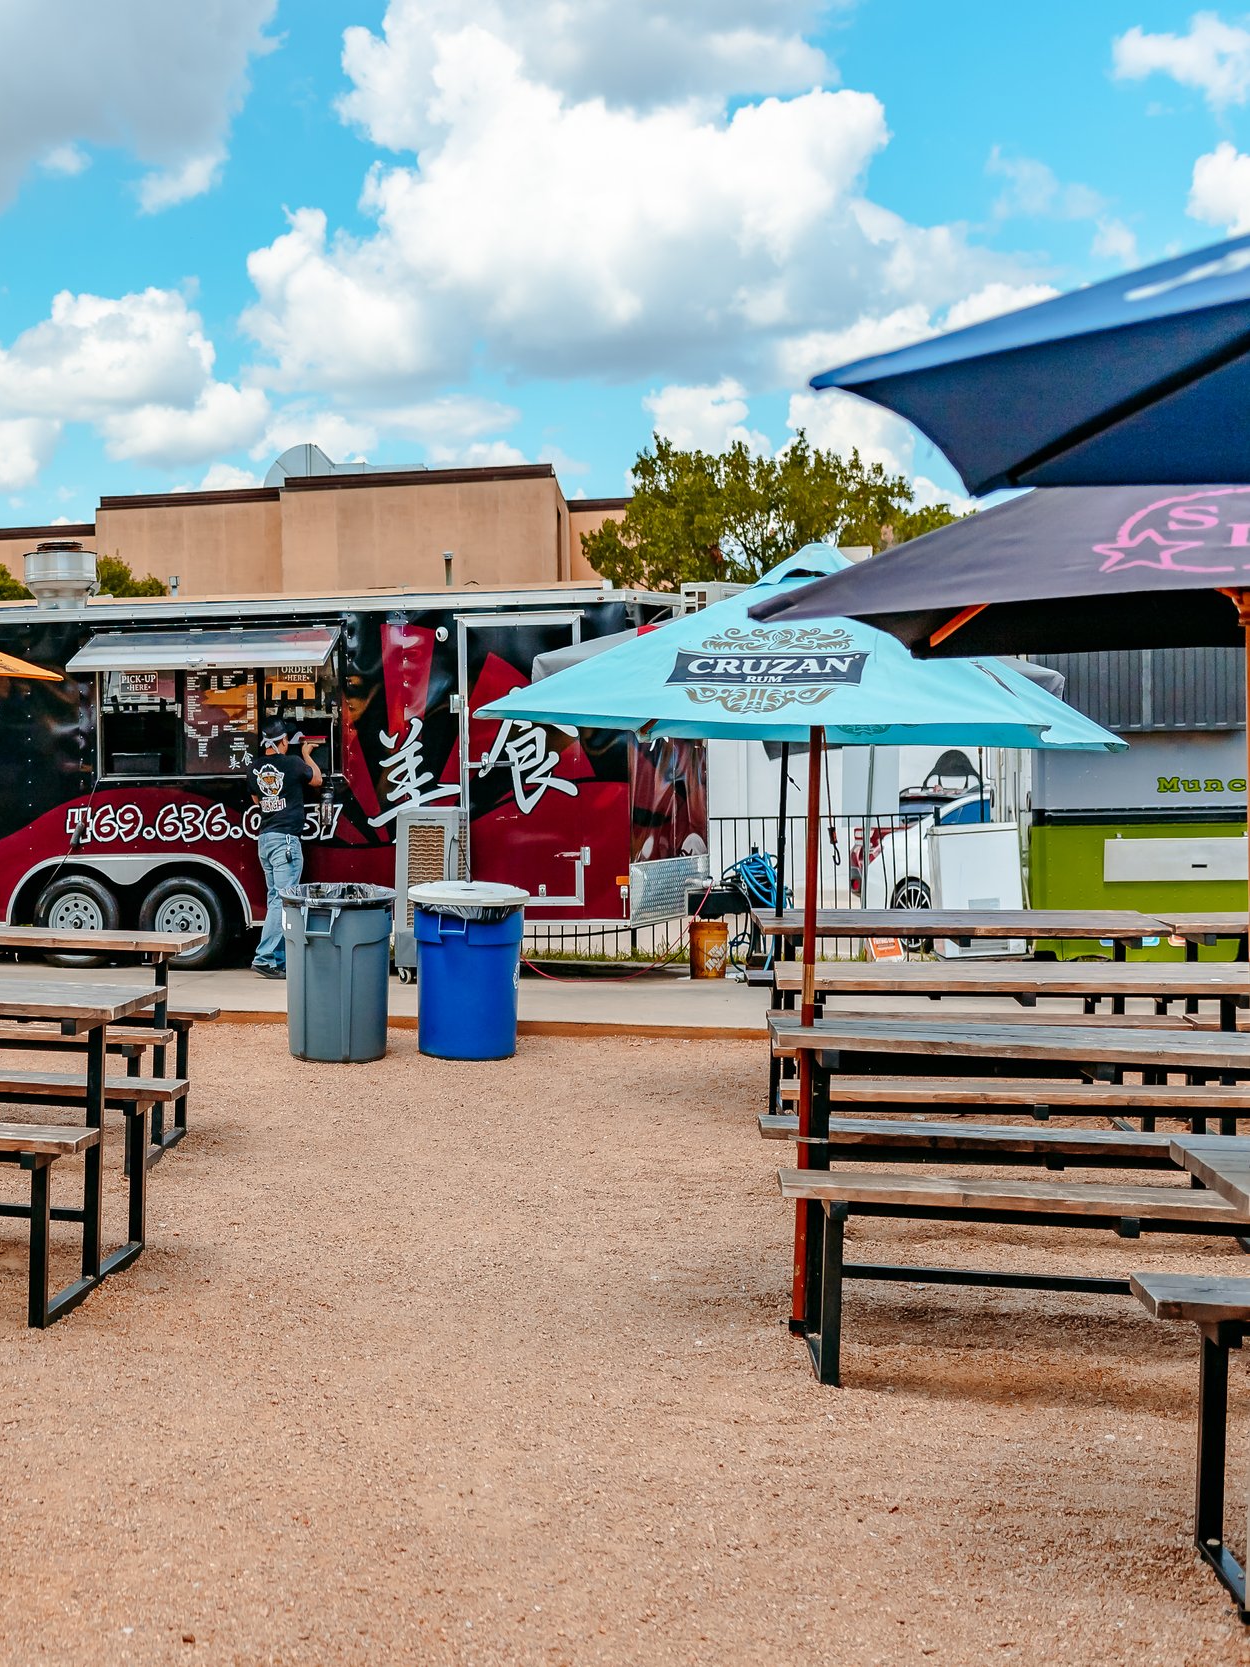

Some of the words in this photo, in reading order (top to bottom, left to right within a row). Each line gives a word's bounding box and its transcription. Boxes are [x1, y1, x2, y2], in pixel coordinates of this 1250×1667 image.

[281, 665, 313, 674] ORDER
[686, 656, 854, 675] CRUZAN
[121, 674, 156, 683] PICK-UP
[744, 675, 784, 683] RUM
[129, 683, 149, 691] HERE
[65, 803, 344, 843] 469.636.057
